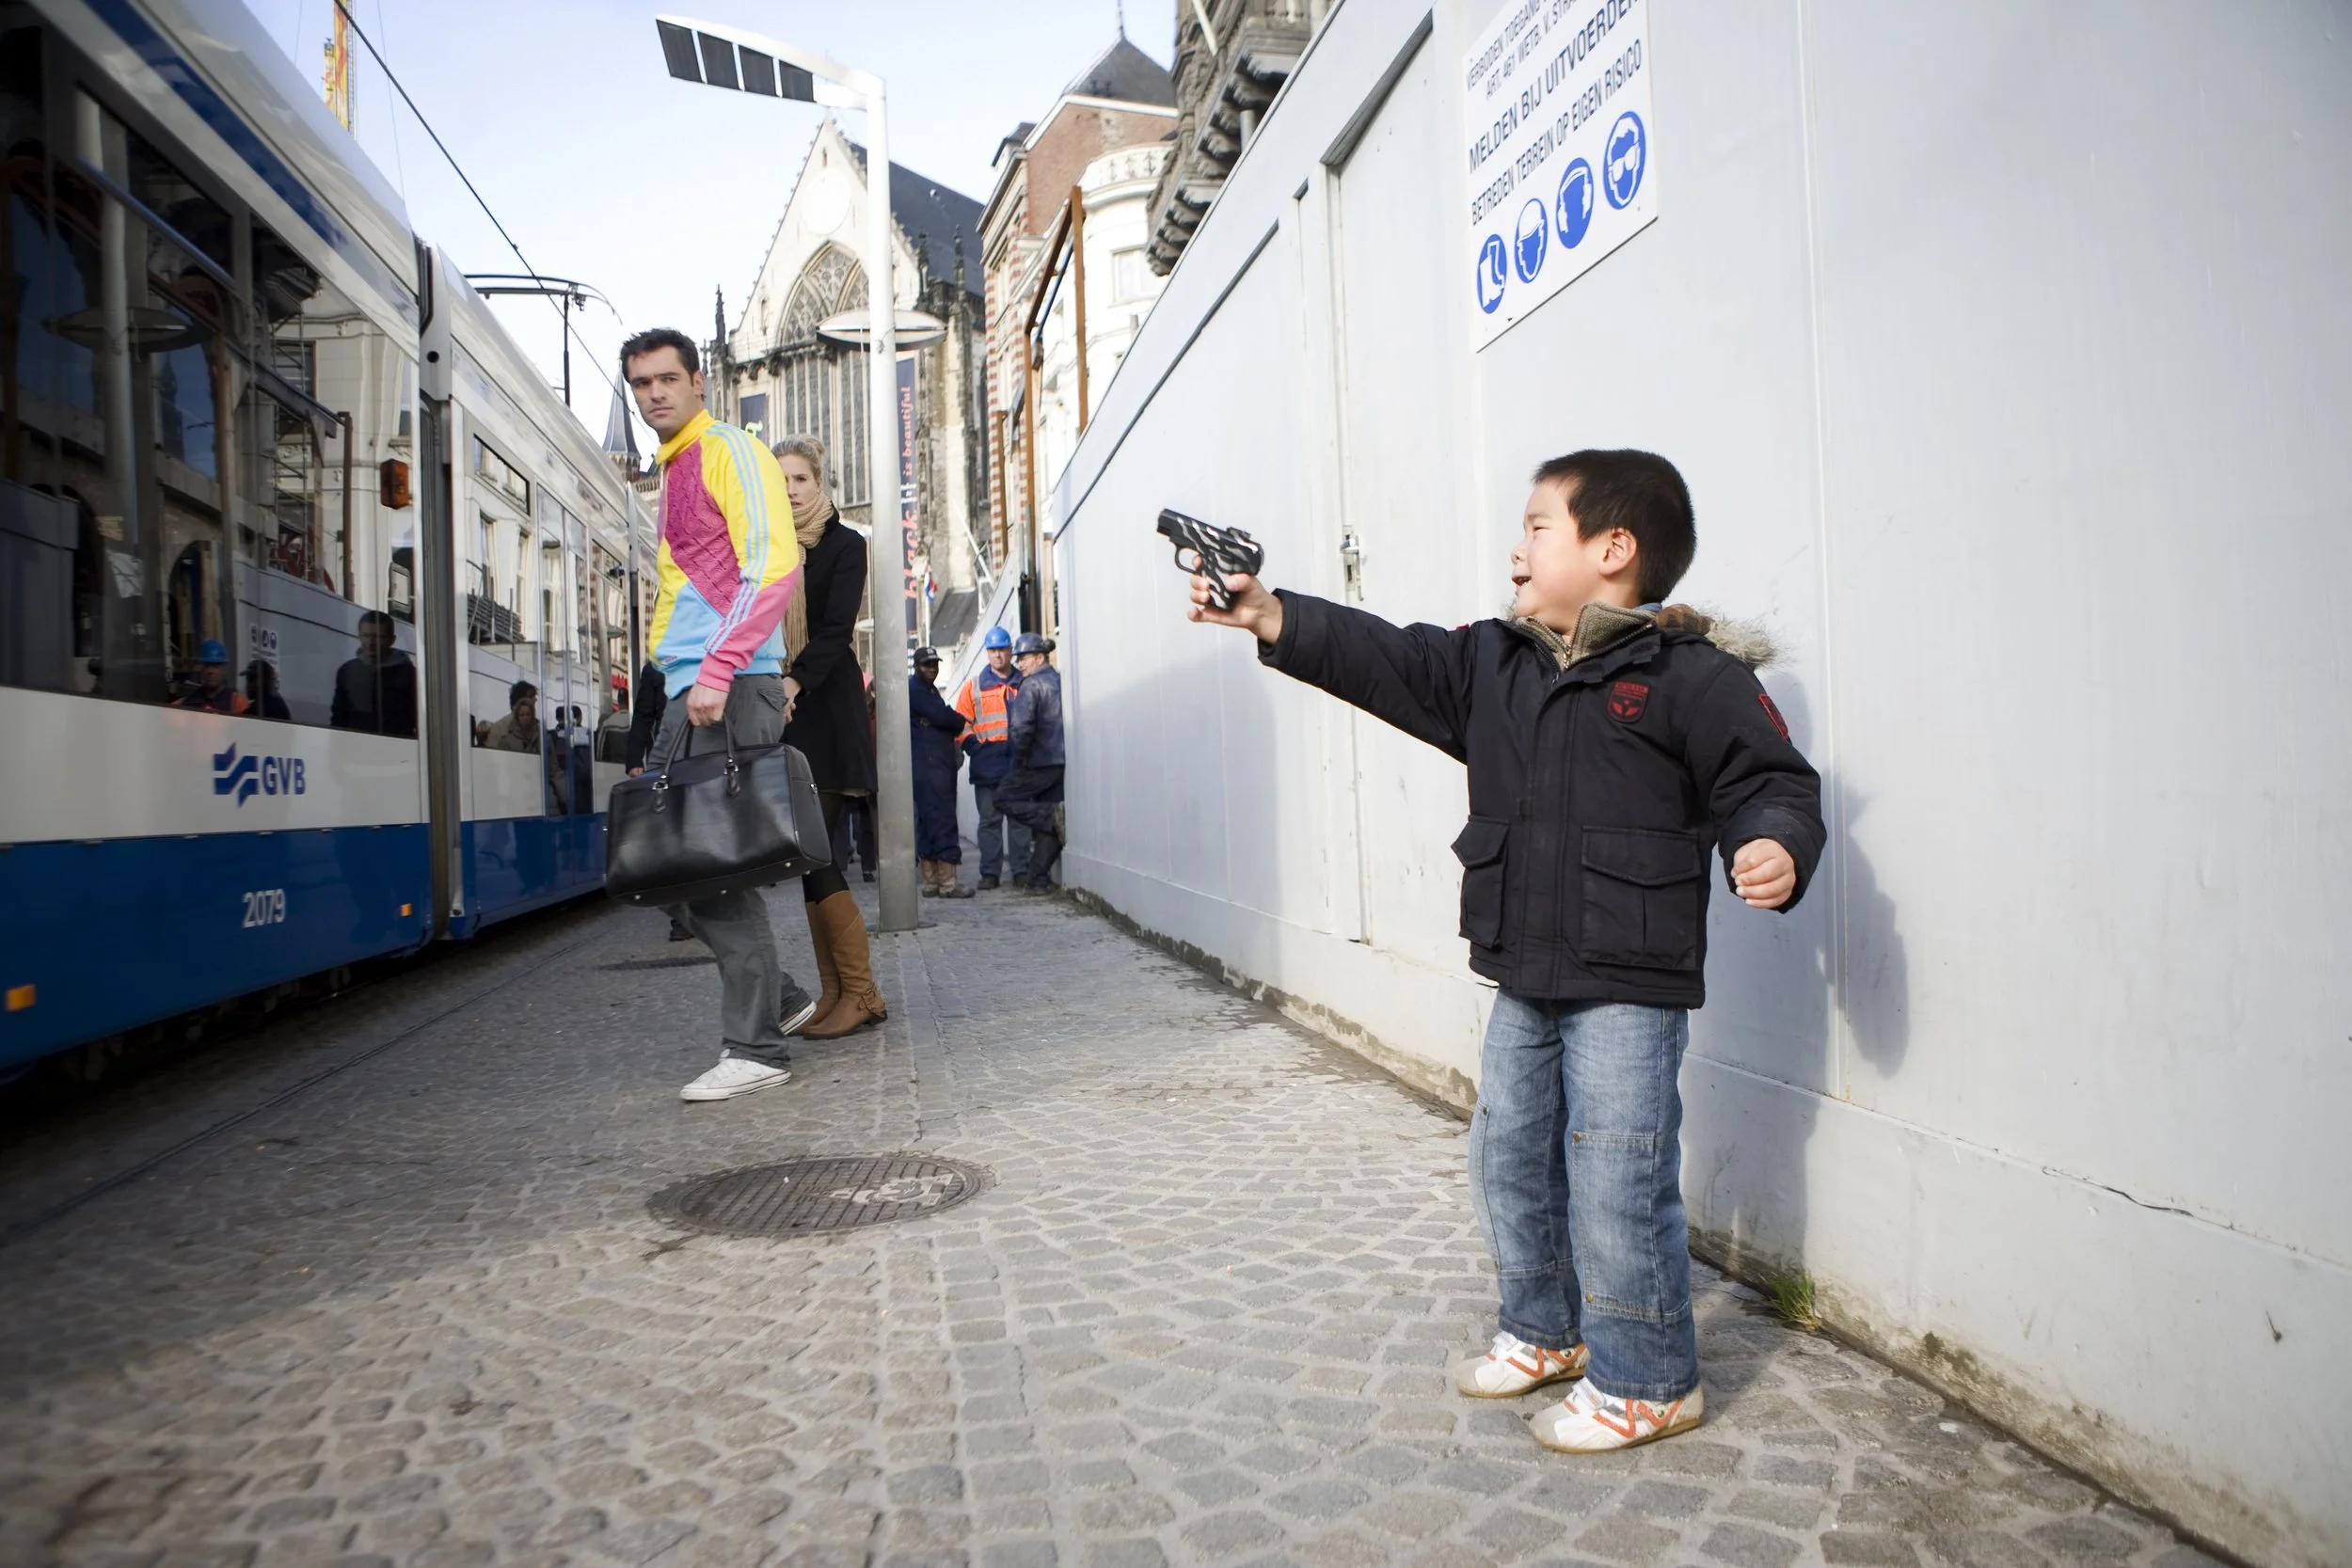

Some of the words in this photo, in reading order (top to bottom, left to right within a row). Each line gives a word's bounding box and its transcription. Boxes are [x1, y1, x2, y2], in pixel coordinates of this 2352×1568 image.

[1467, 33, 1503, 91] VERBODEN
[1470, 102, 1518, 174] MELDEN
[1521, 76, 1542, 120] BIJ
[1471, 165, 1514, 227] BETREDEN
[1517, 126, 1554, 184] TERREIN
[1557, 111, 1569, 146] OP
[1572, 78, 1601, 132] EIGEN
[1605, 39, 1642, 101] RISICO
[900, 386, 914, 457] beautiful
[262, 755, 306, 797] GVB
[242, 888, 286, 928] 2079
